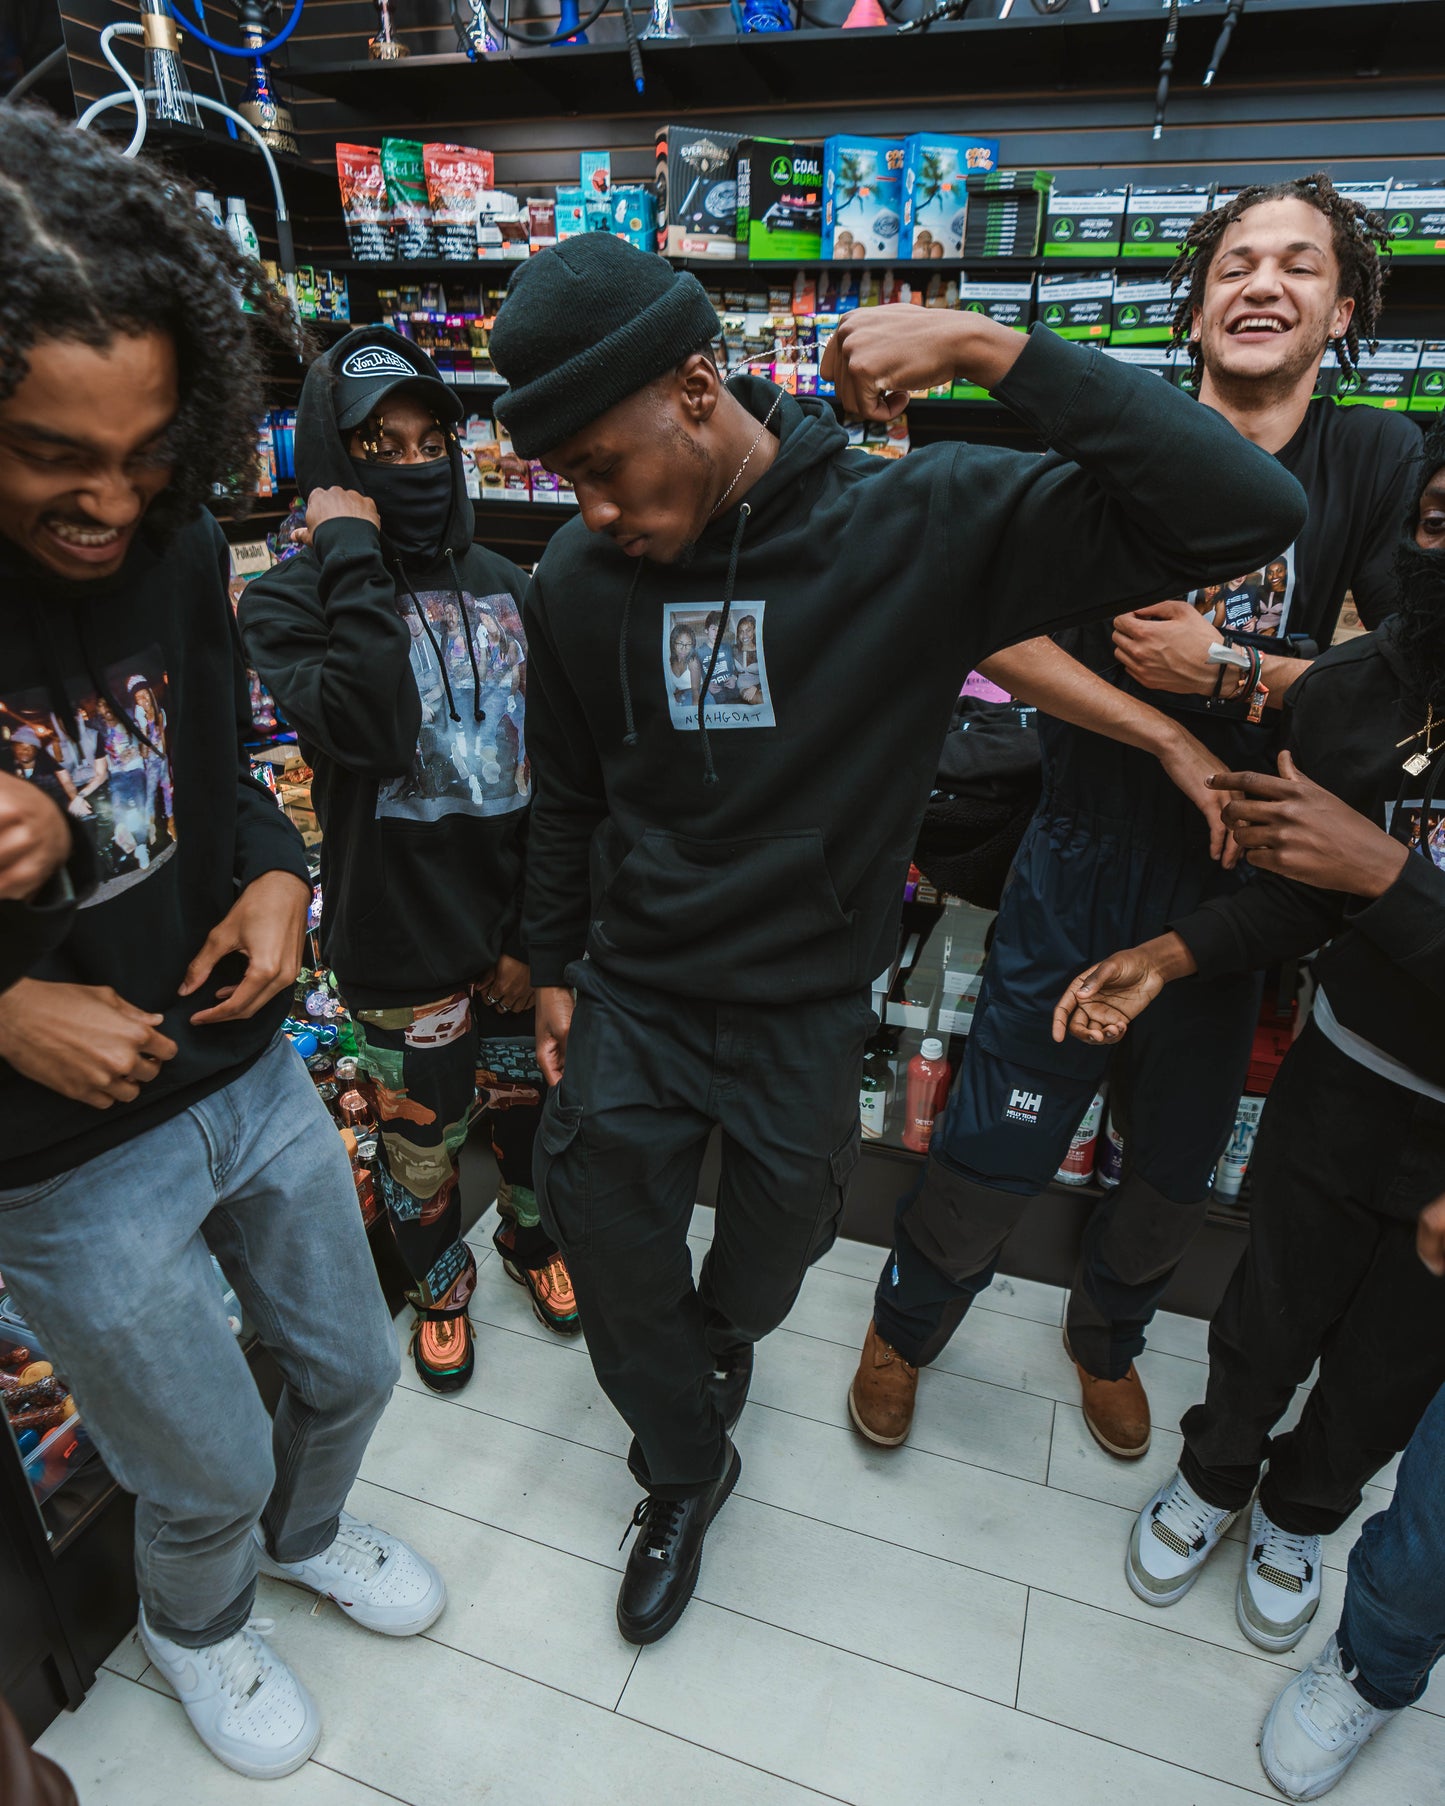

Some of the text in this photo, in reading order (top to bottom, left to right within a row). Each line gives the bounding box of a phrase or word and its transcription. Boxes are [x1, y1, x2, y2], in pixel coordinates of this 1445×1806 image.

[343, 161, 368, 180] Red
[429, 160, 455, 178] Red
[456, 160, 490, 178] River
[793, 158, 820, 175] COAL
[792, 171, 824, 188] BURNE
[350, 352, 408, 371] Von Dutch
[1009, 1089, 1043, 1112] HH
